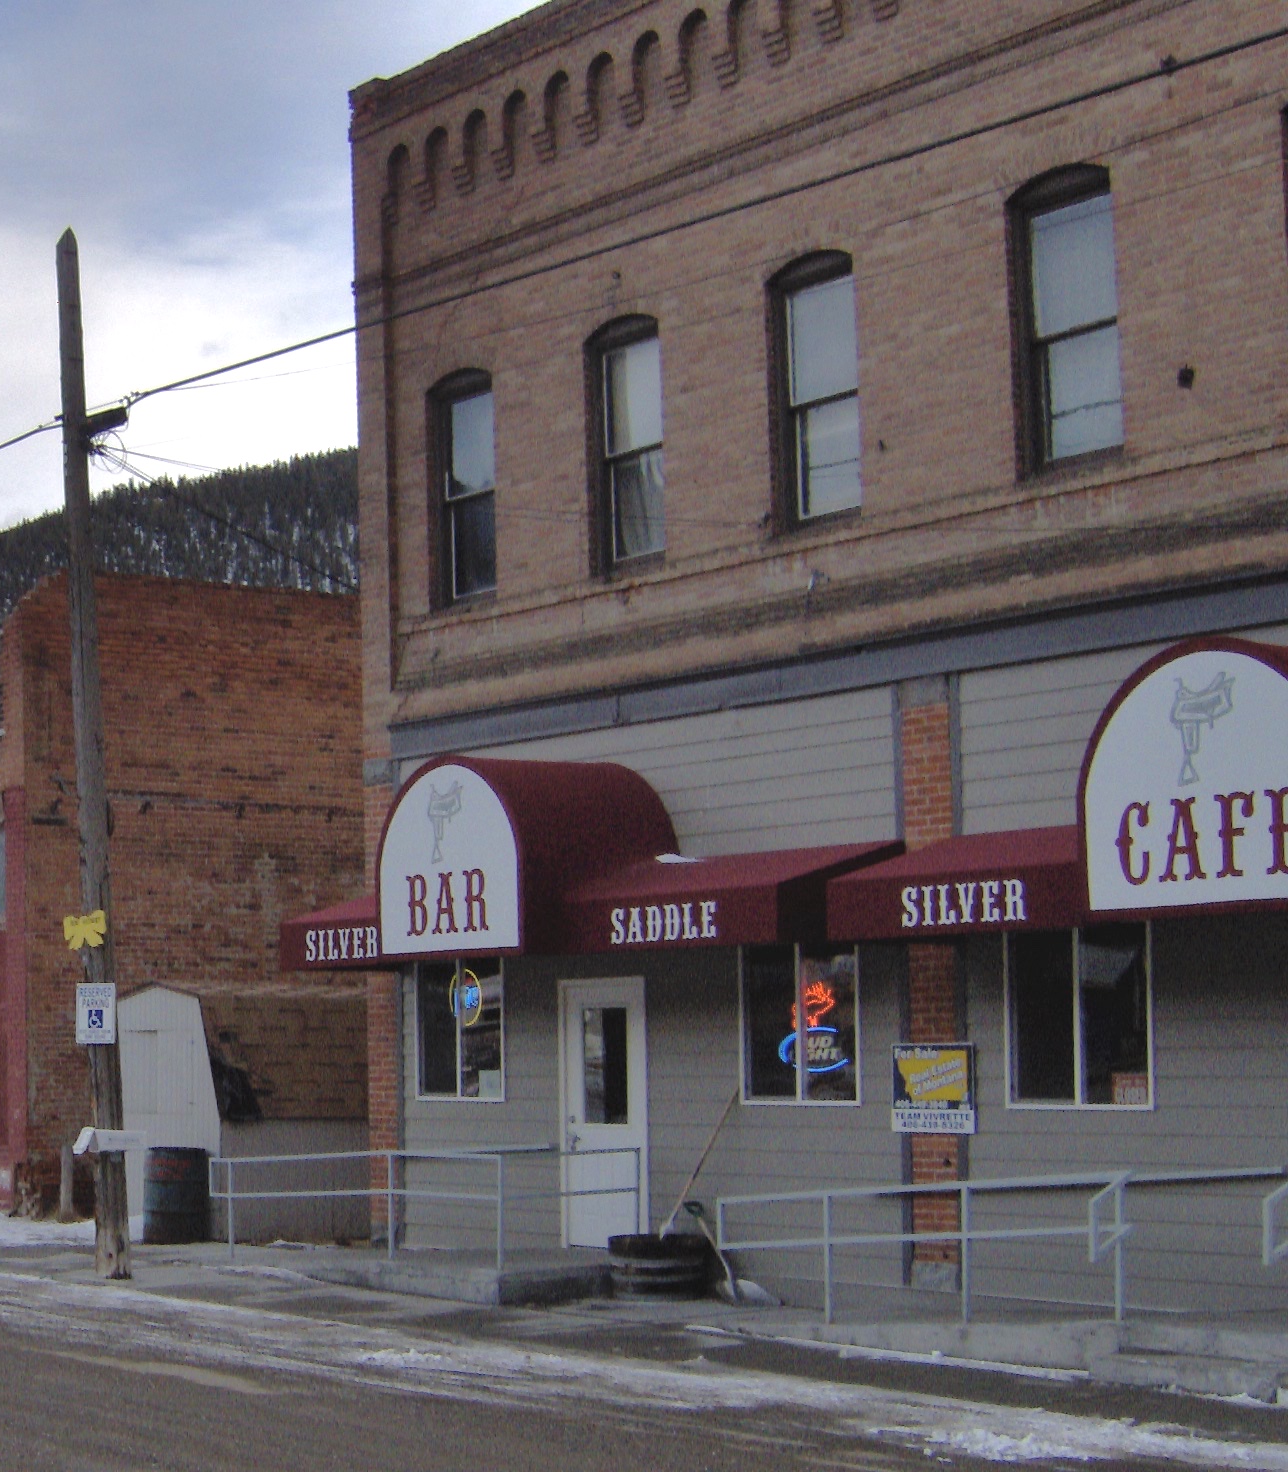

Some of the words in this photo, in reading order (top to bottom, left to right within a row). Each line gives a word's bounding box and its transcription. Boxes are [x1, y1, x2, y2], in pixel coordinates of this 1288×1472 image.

[406, 868, 489, 937] BAR
[901, 878, 1028, 928] SILVER
[610, 900, 717, 945] SADDLE
[305, 926, 379, 962] SILVER
[79, 987, 112, 998] RESERVED
[81, 998, 110, 1008] PARKING
[894, 1048, 911, 1059] For
[914, 1048, 938, 1059] Sale
[895, 1112, 921, 1120] TEAM
